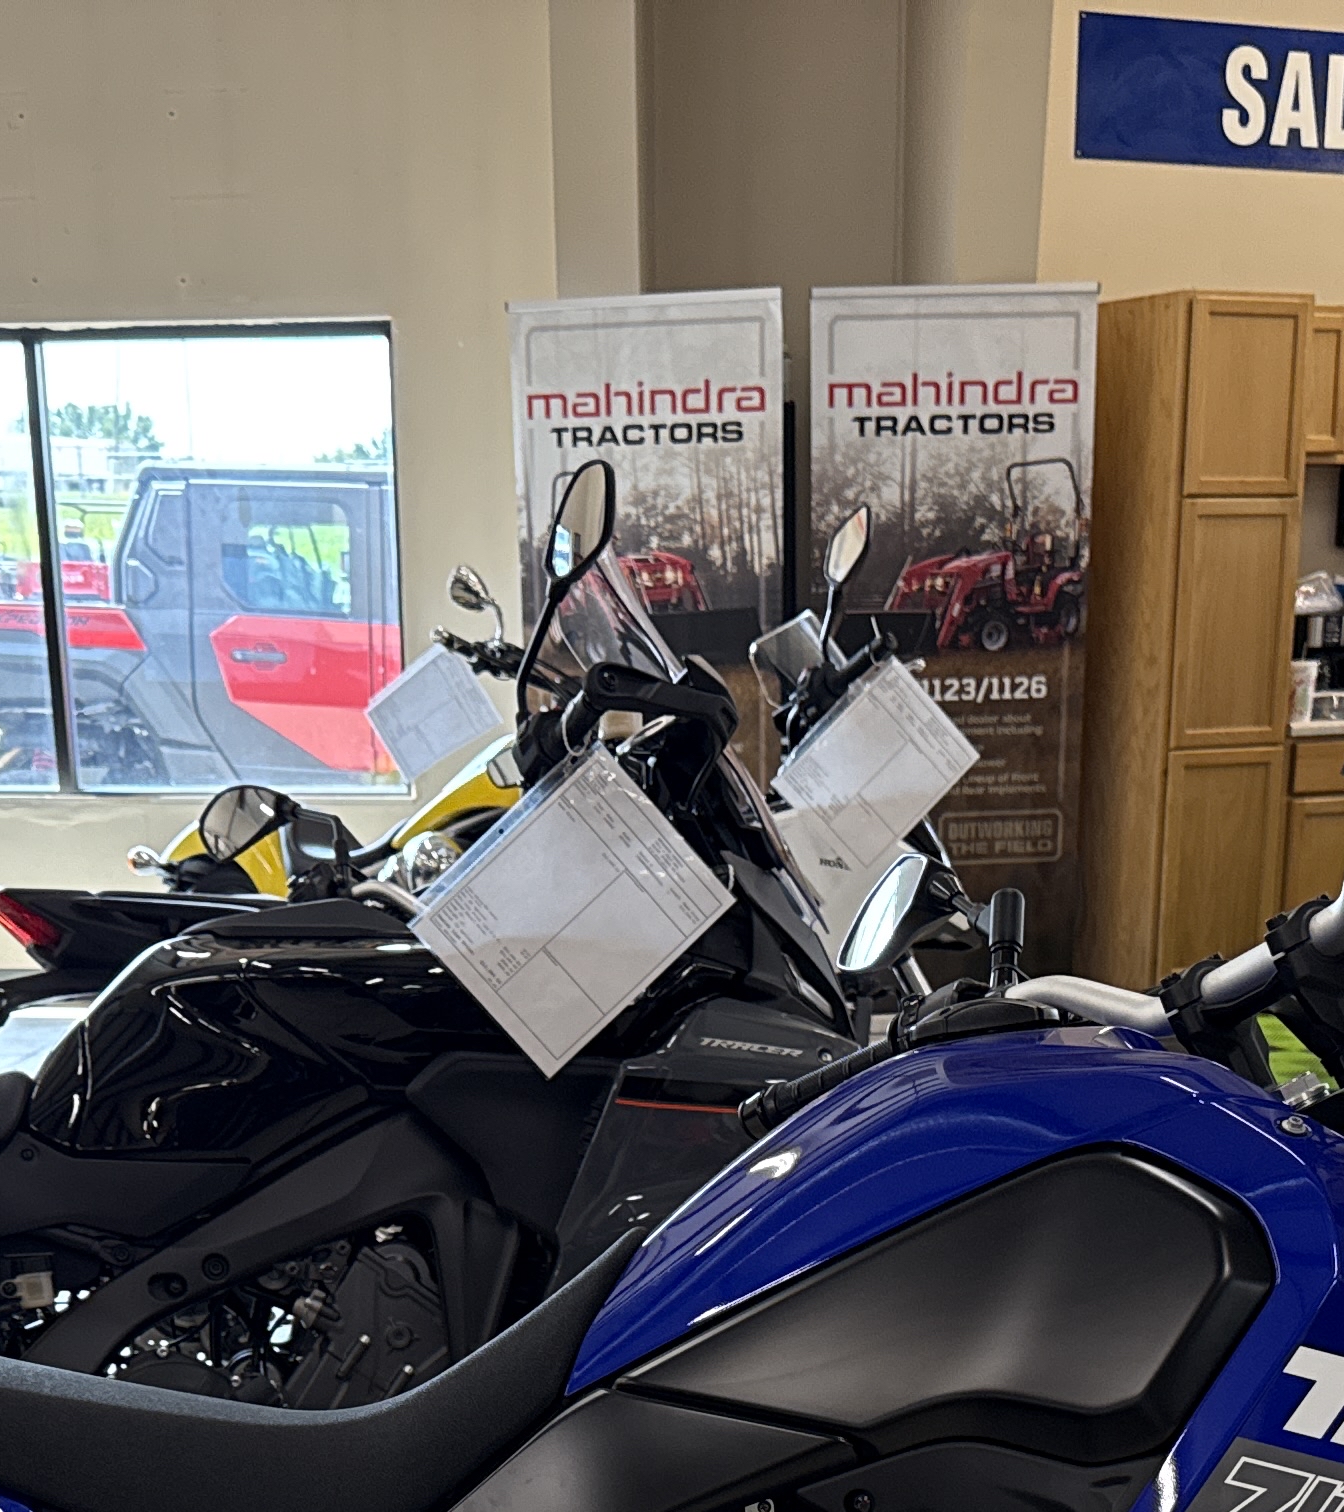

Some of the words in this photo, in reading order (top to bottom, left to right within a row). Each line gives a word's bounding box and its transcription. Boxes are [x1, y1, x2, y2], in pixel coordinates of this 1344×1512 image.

[526, 379, 767, 420] mahindra
[826, 371, 1079, 409] mahindra
[549, 421, 745, 449] TRACTORS
[851, 413, 1056, 438] TRACTORS
[947, 819, 1053, 841] OUTWORKING
[950, 840, 989, 856] THE
[994, 839, 1053, 854] FIELD
[699, 1036, 804, 1058] TRACER
